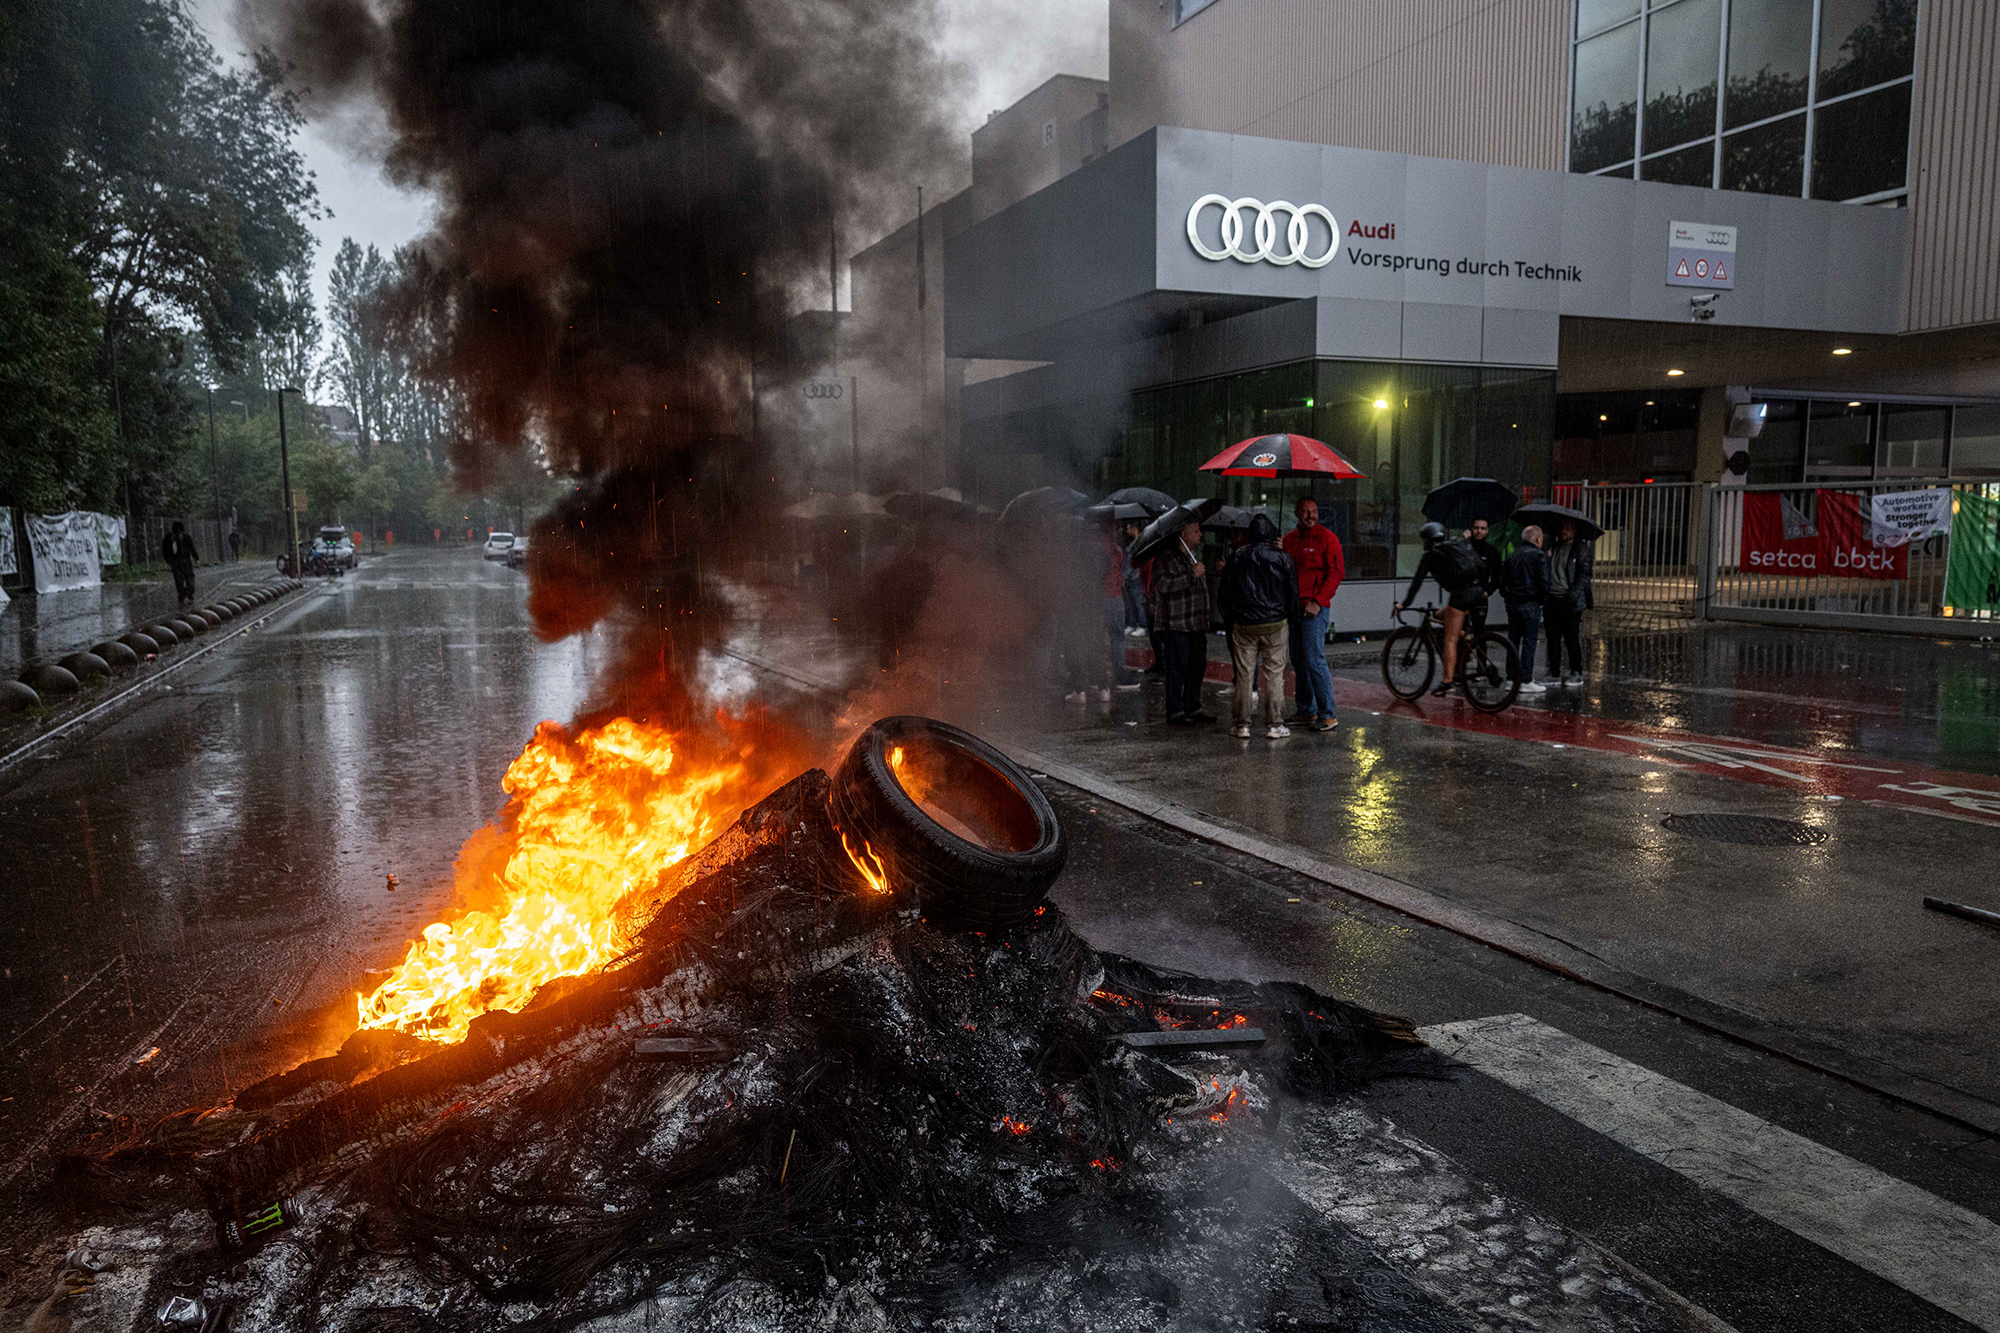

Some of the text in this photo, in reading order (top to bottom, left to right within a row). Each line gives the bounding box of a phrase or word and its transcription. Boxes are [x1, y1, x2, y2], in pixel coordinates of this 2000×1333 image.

[1348, 220, 1395, 240] Audi
[1347, 247, 1582, 282] Vorsprung durch Technik
[1882, 493, 1940, 506] Automotive
[1893, 503, 1933, 512] workers
[1886, 512, 1928, 522] Stronger
[1897, 517, 1939, 528] together
[1749, 548, 1816, 569] setca
[1834, 545, 1894, 570] bbtk
